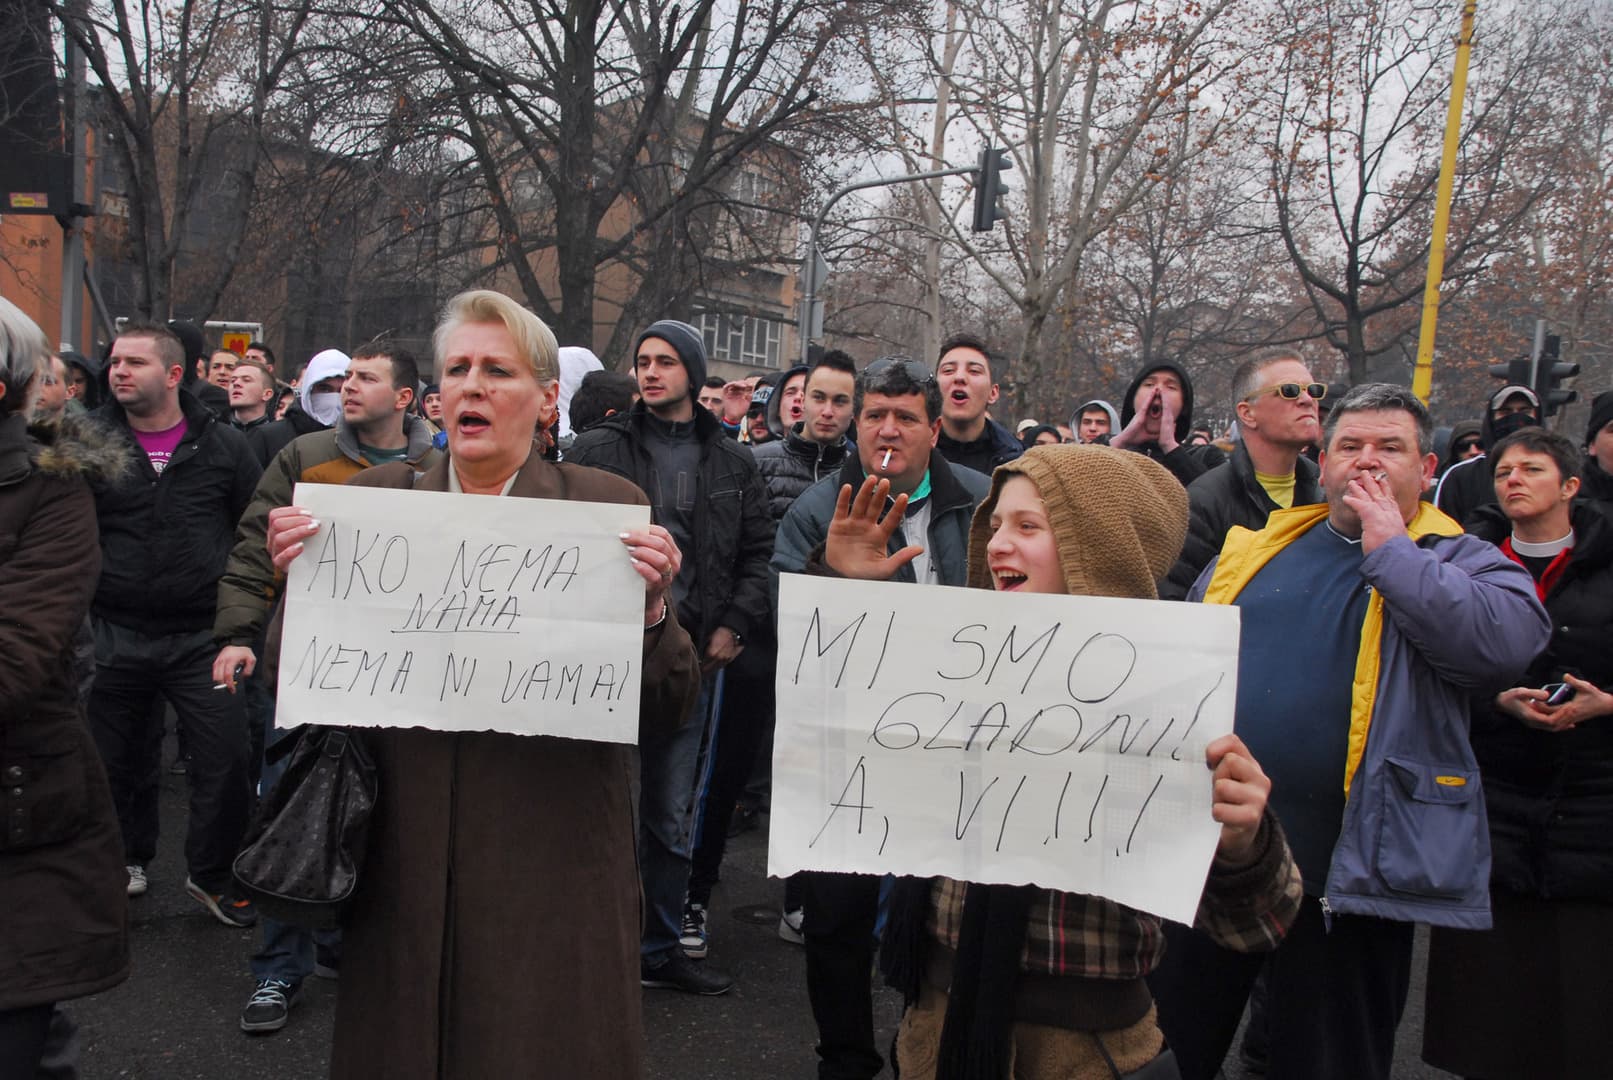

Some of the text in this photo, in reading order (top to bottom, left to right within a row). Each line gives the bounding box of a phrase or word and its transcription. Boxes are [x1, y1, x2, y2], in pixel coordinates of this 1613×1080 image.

[307, 521, 581, 600] AKO NEMA
[402, 590, 521, 632] NAMA
[289, 636, 630, 712] NEMA NI VAMA!
[792, 607, 1137, 703] MI SMO
[868, 672, 1225, 761] GLADNI!
[809, 756, 1164, 856] A, VI!!!
